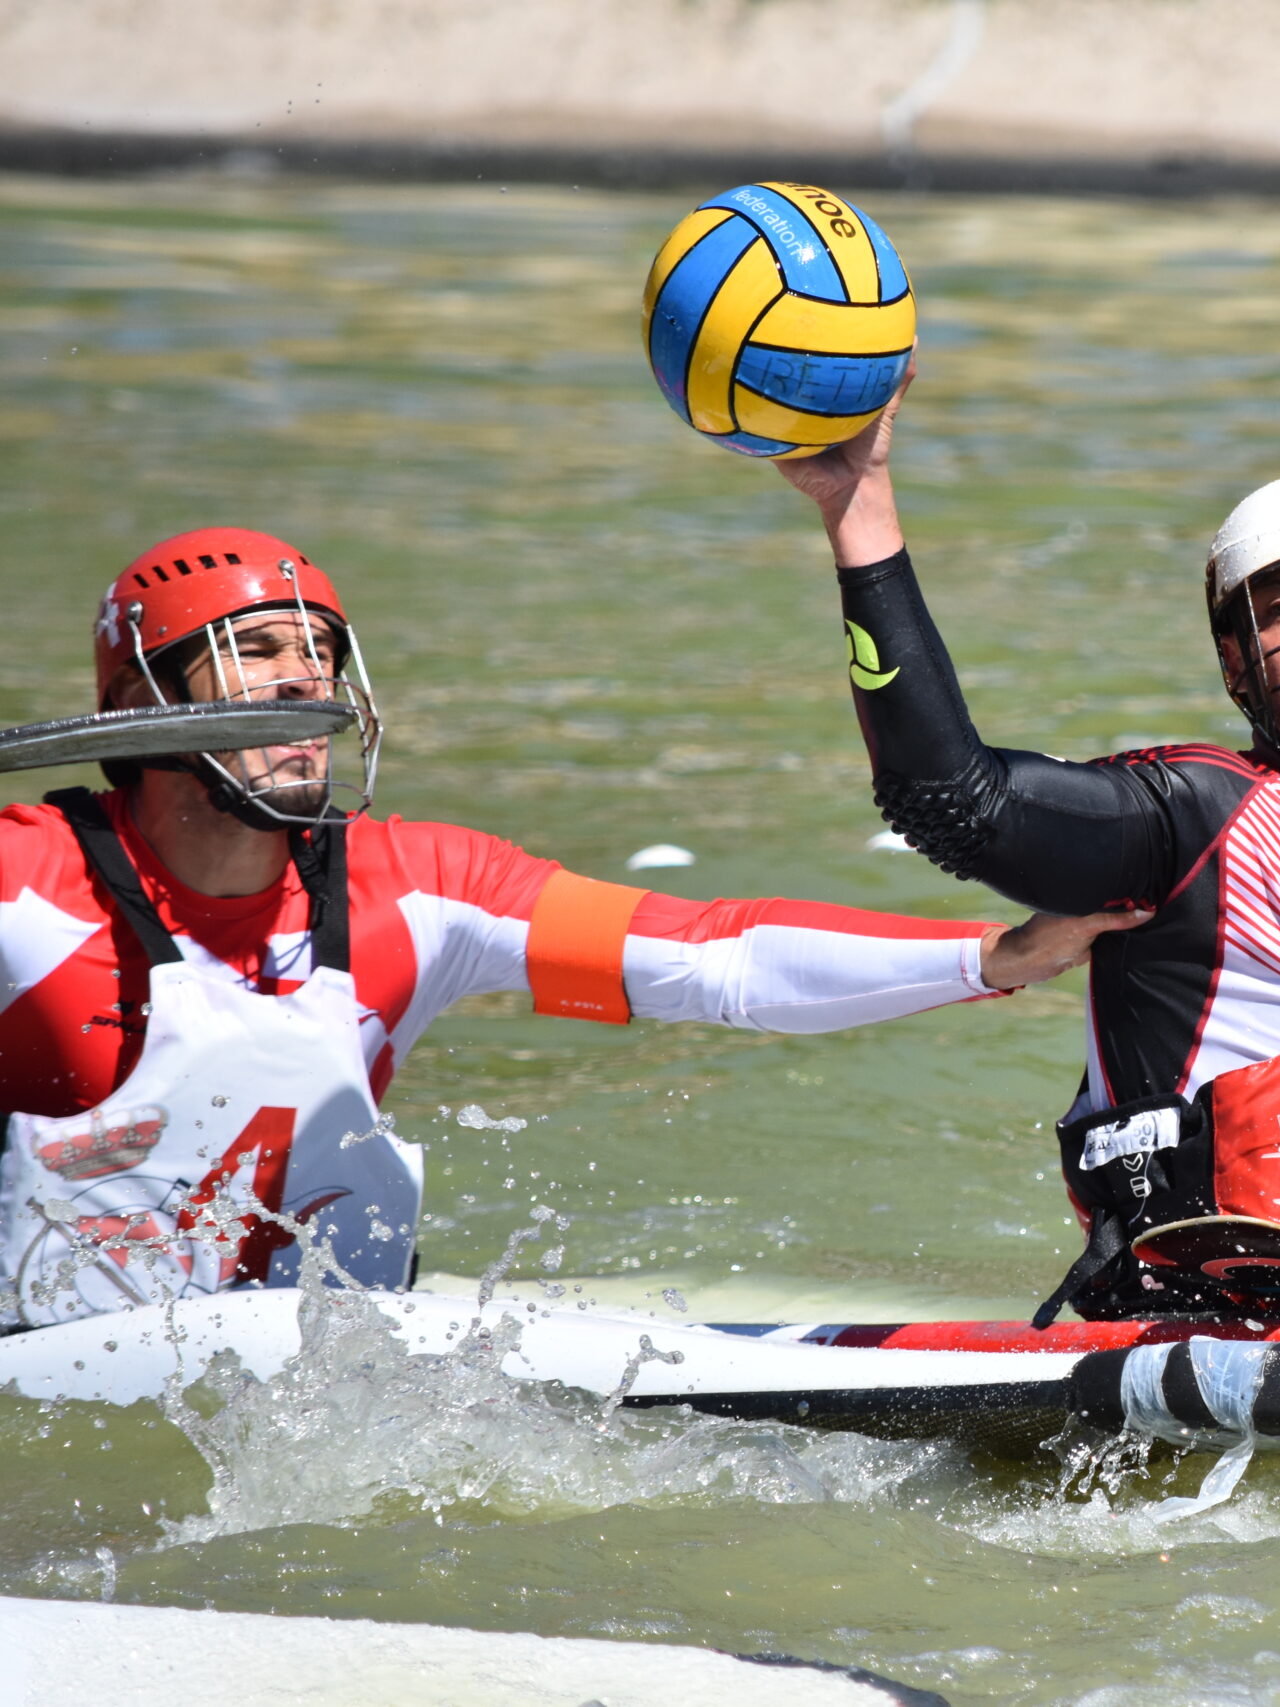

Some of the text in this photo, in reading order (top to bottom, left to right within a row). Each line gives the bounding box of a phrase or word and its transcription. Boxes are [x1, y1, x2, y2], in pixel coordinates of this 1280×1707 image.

[731, 189, 803, 256] federation
[777, 182, 857, 239] noe
[175, 1106, 297, 1283] 4
